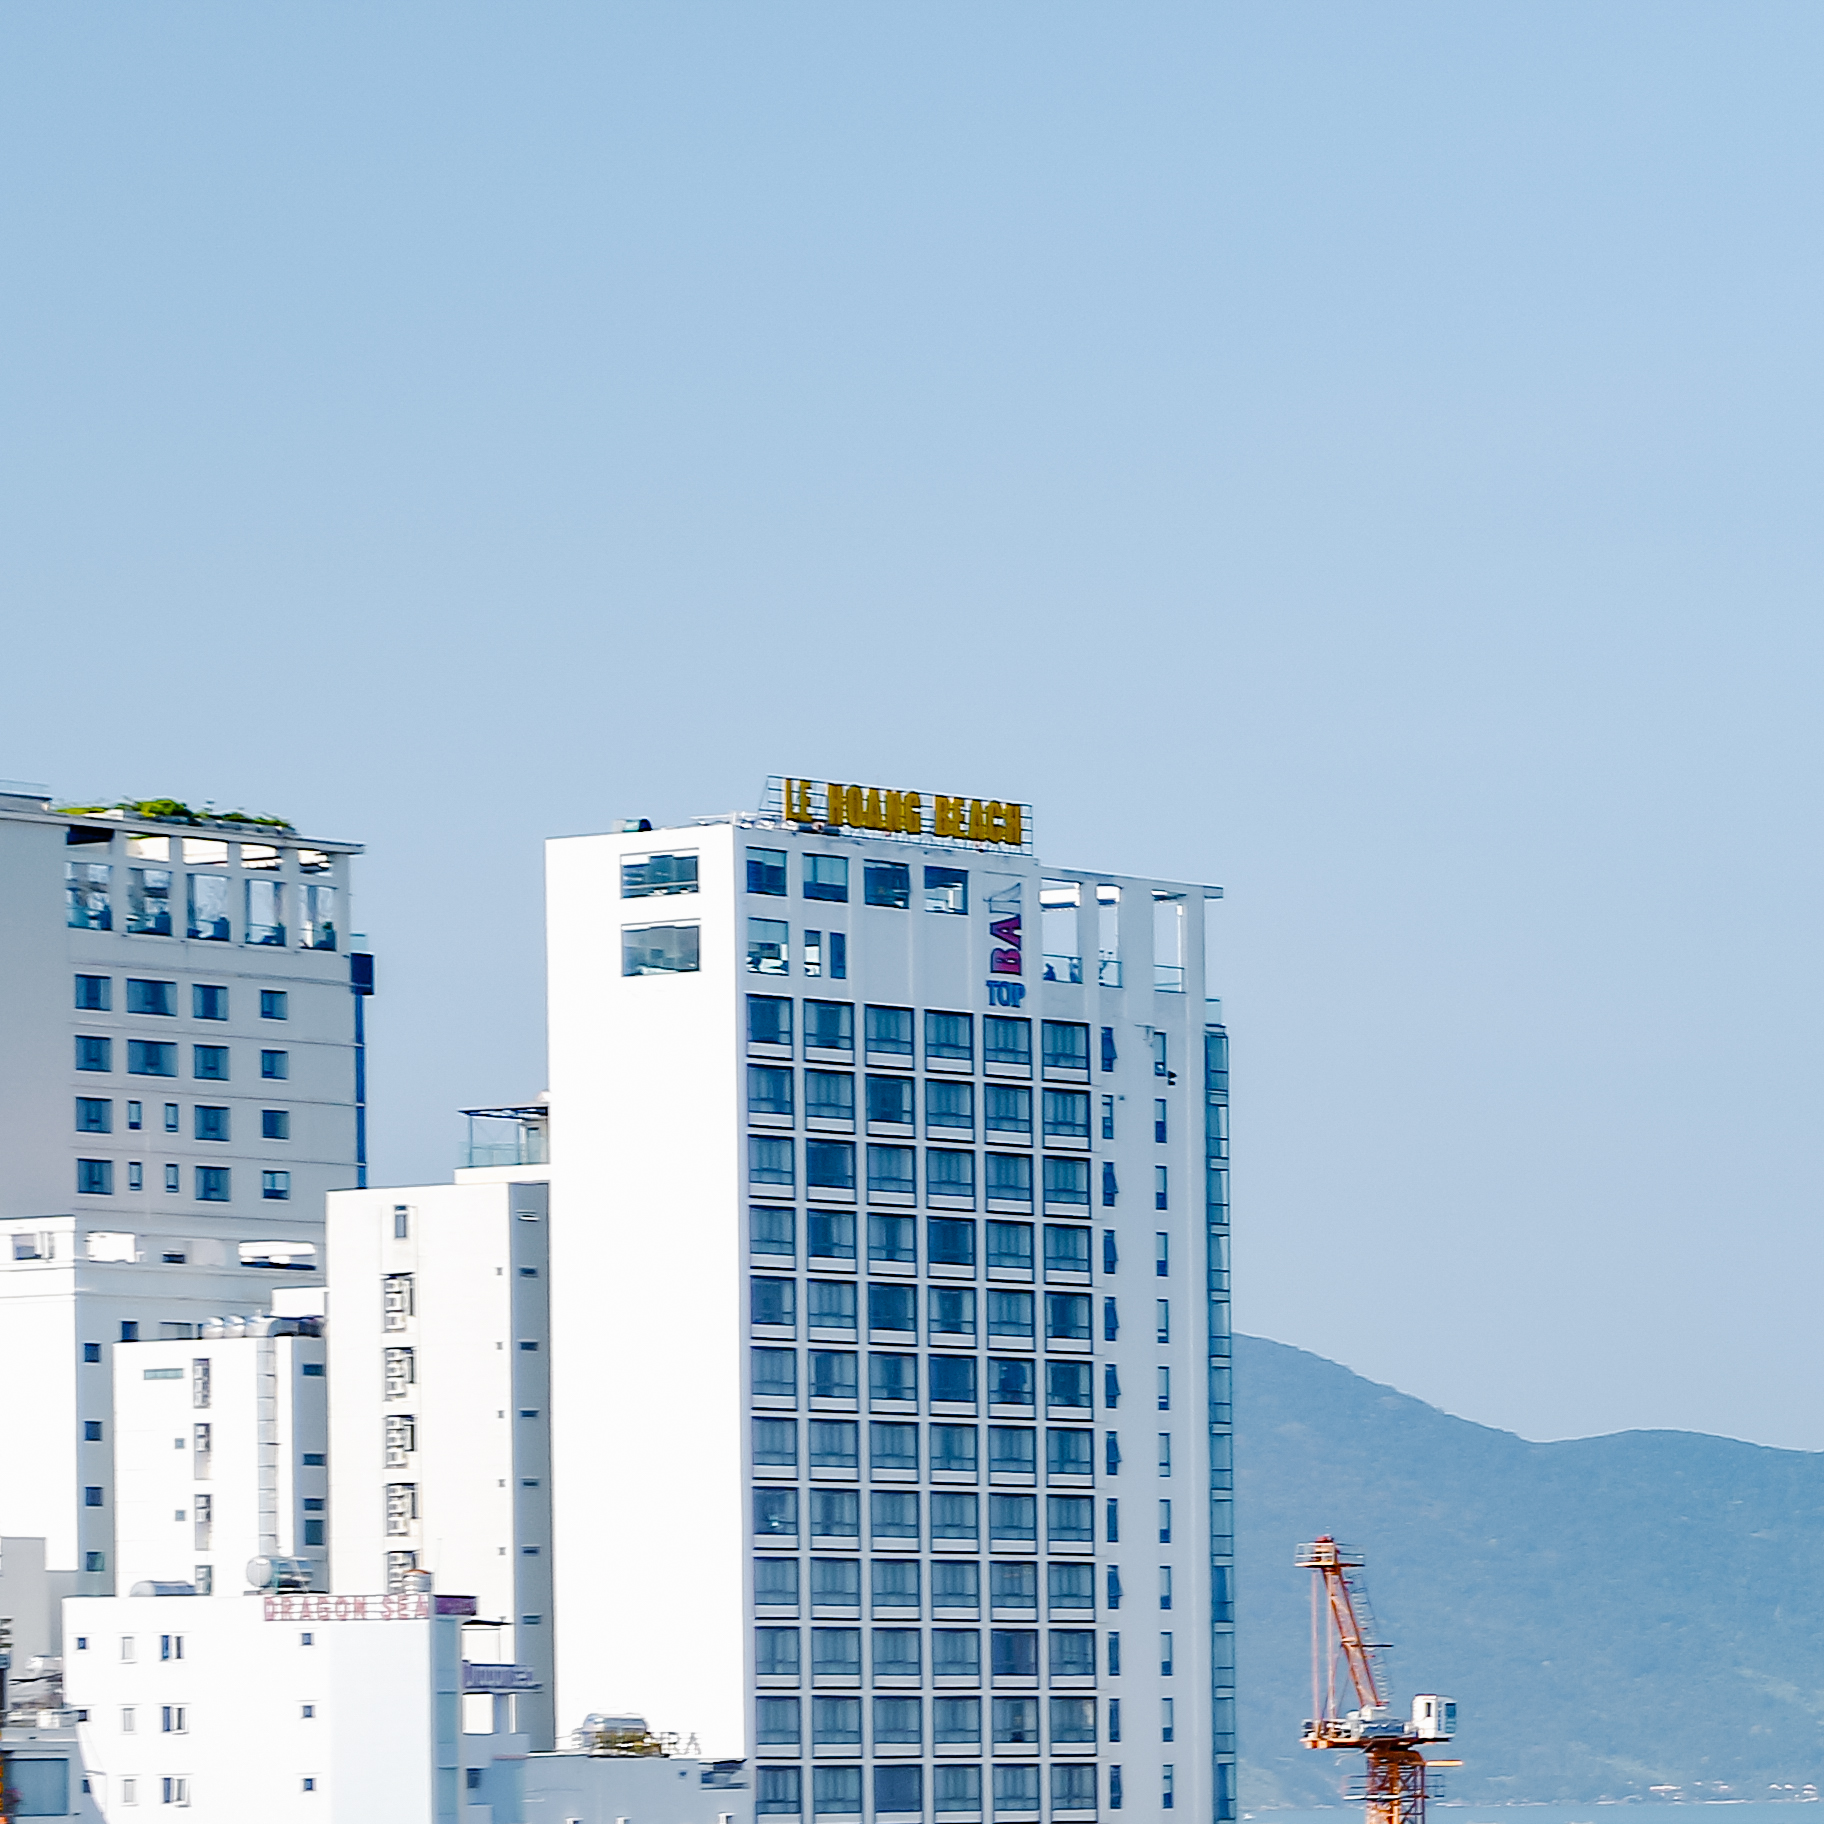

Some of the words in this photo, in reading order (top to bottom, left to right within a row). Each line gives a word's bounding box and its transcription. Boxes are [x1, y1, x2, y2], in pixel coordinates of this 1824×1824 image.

[785, 778, 813, 823] LE
[827, 782, 922, 834] HOANG
[934, 794, 1022, 845] BEACH
[985, 979, 1026, 1008] TOP
[264, 1595, 367, 1621] DRAGON
[382, 1592, 430, 1620] SEA
